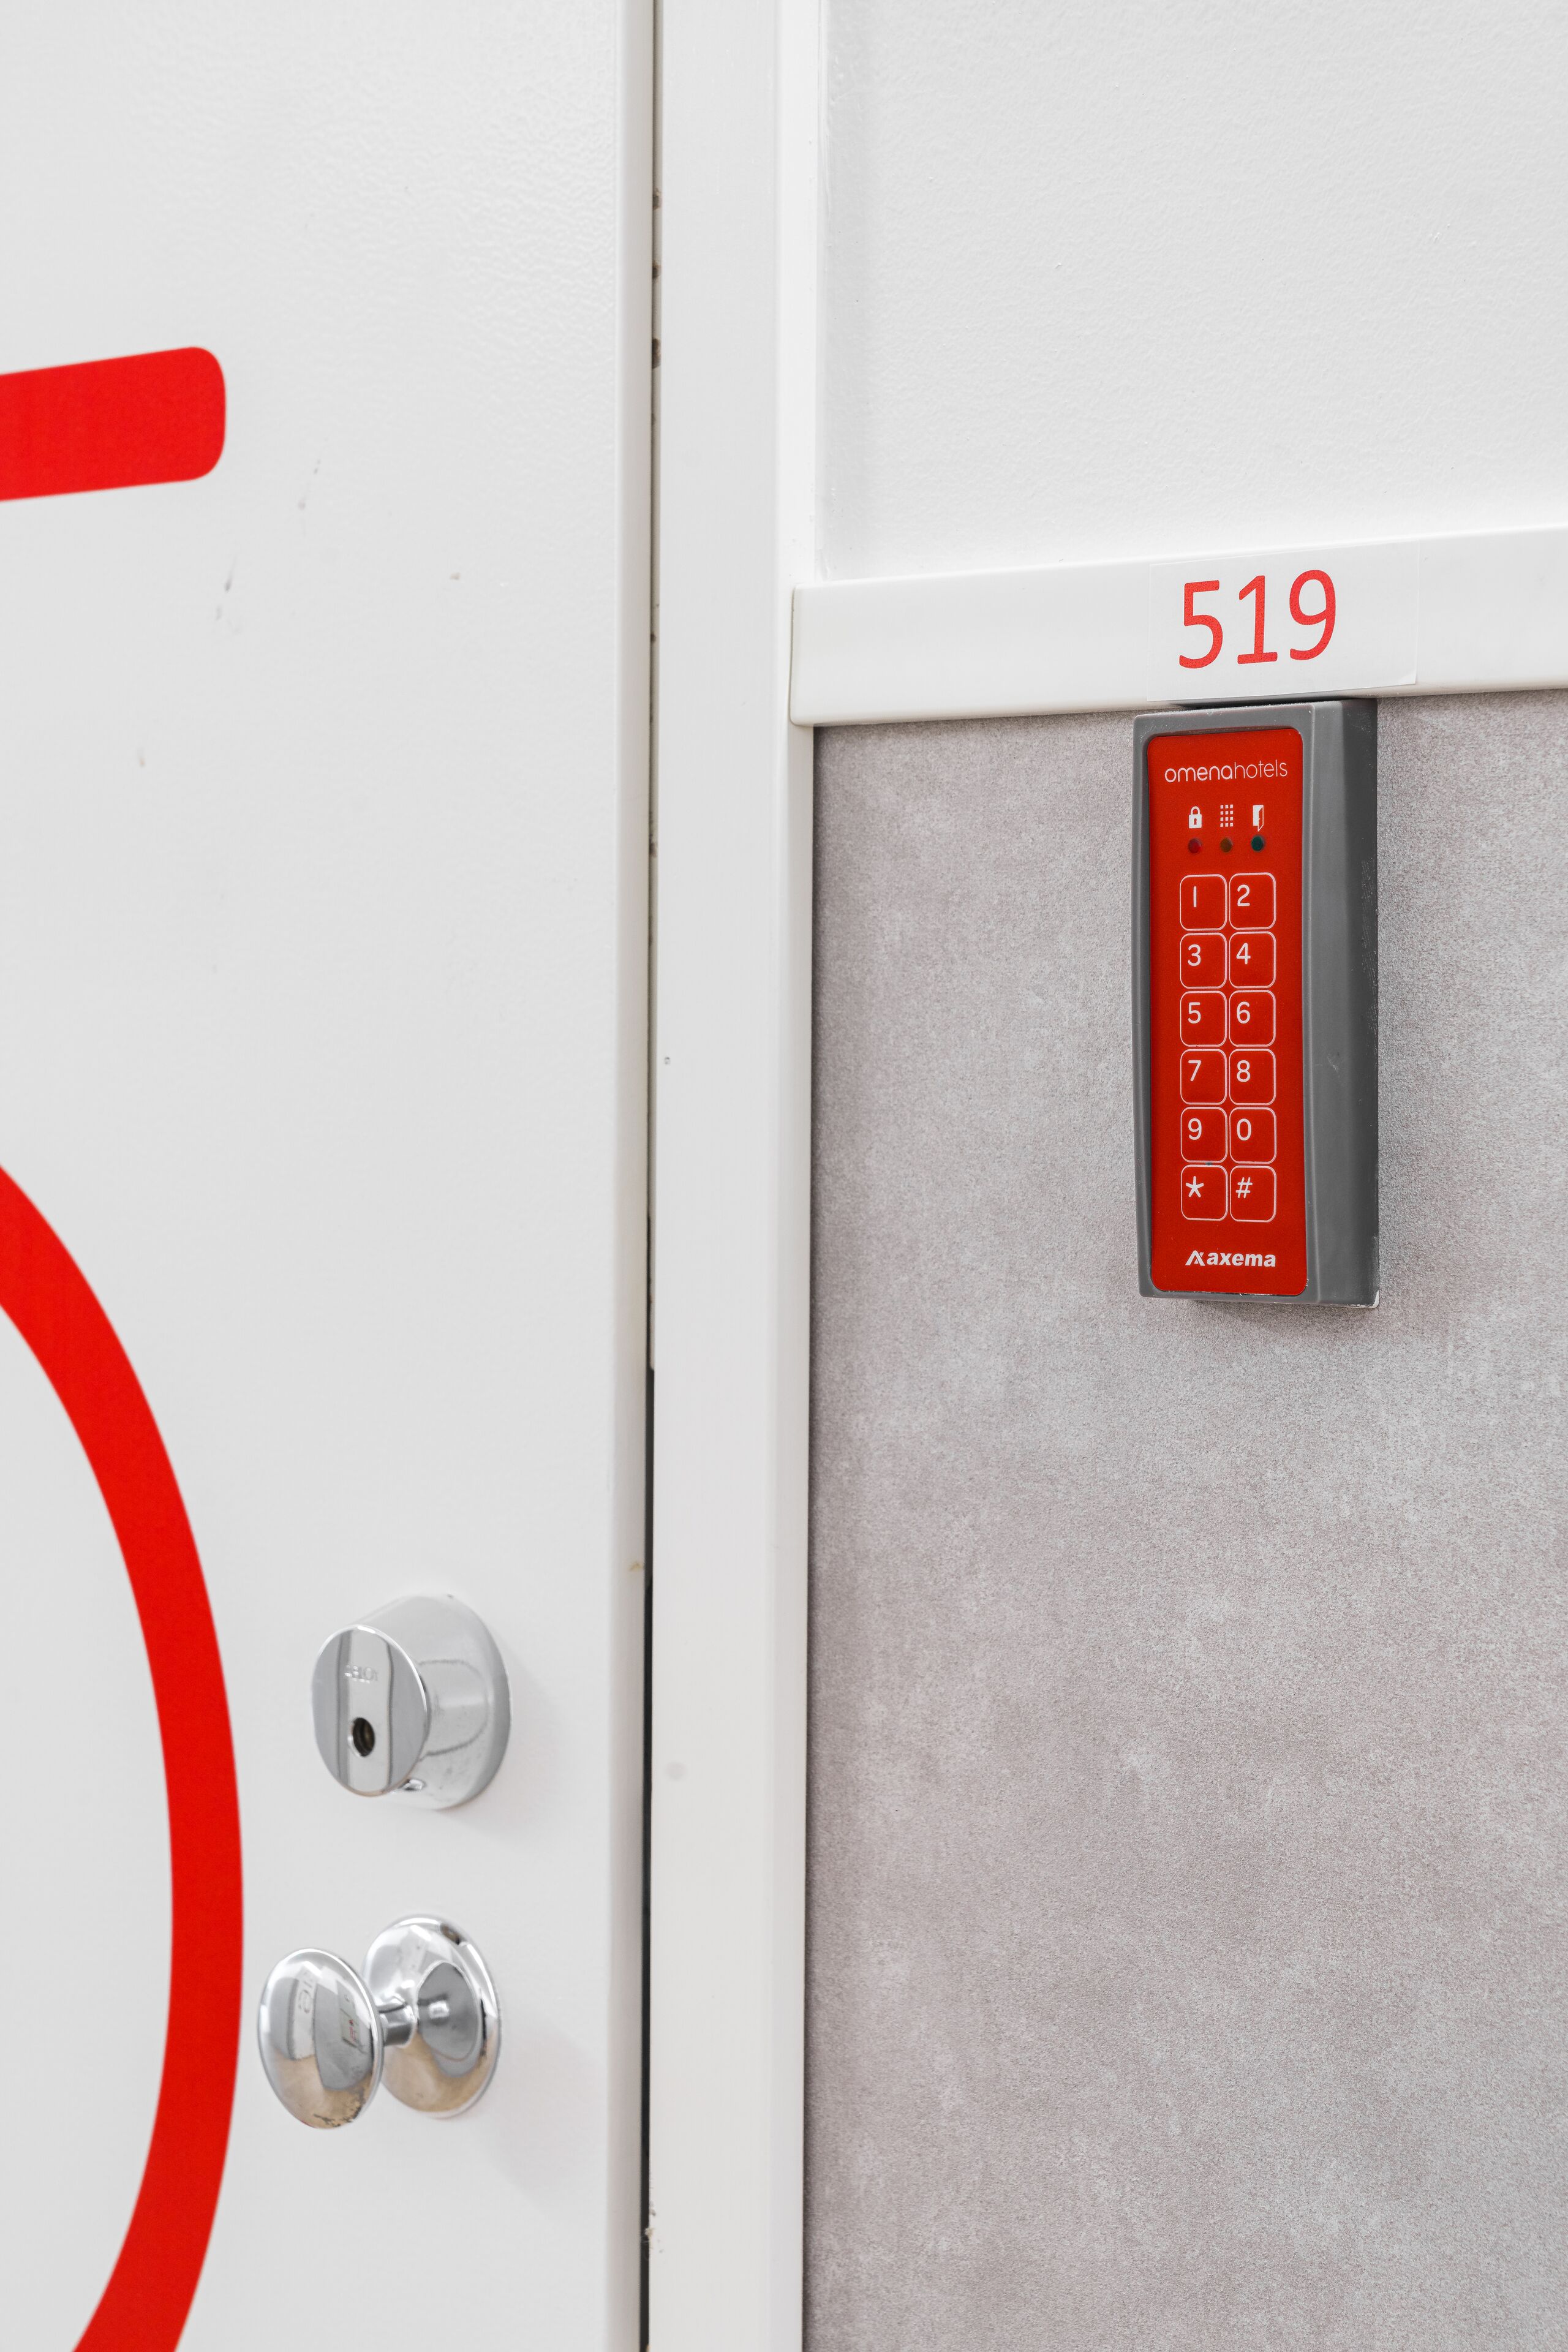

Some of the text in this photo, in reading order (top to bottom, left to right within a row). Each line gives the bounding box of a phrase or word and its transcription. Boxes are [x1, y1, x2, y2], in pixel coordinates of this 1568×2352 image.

[1178, 569, 1336, 669] 519
[1164, 759, 1288, 783] omenahotels
[1237, 884, 1251, 907] 2
[1187, 942, 1251, 967] 3 4
[1188, 1001, 1251, 1024] 5 6
[1187, 1060, 1251, 1083] 7 8
[1188, 1117, 1252, 1141] 9 0
[1235, 1177, 1253, 1199] #
[1208, 1251, 1276, 1268] axema
